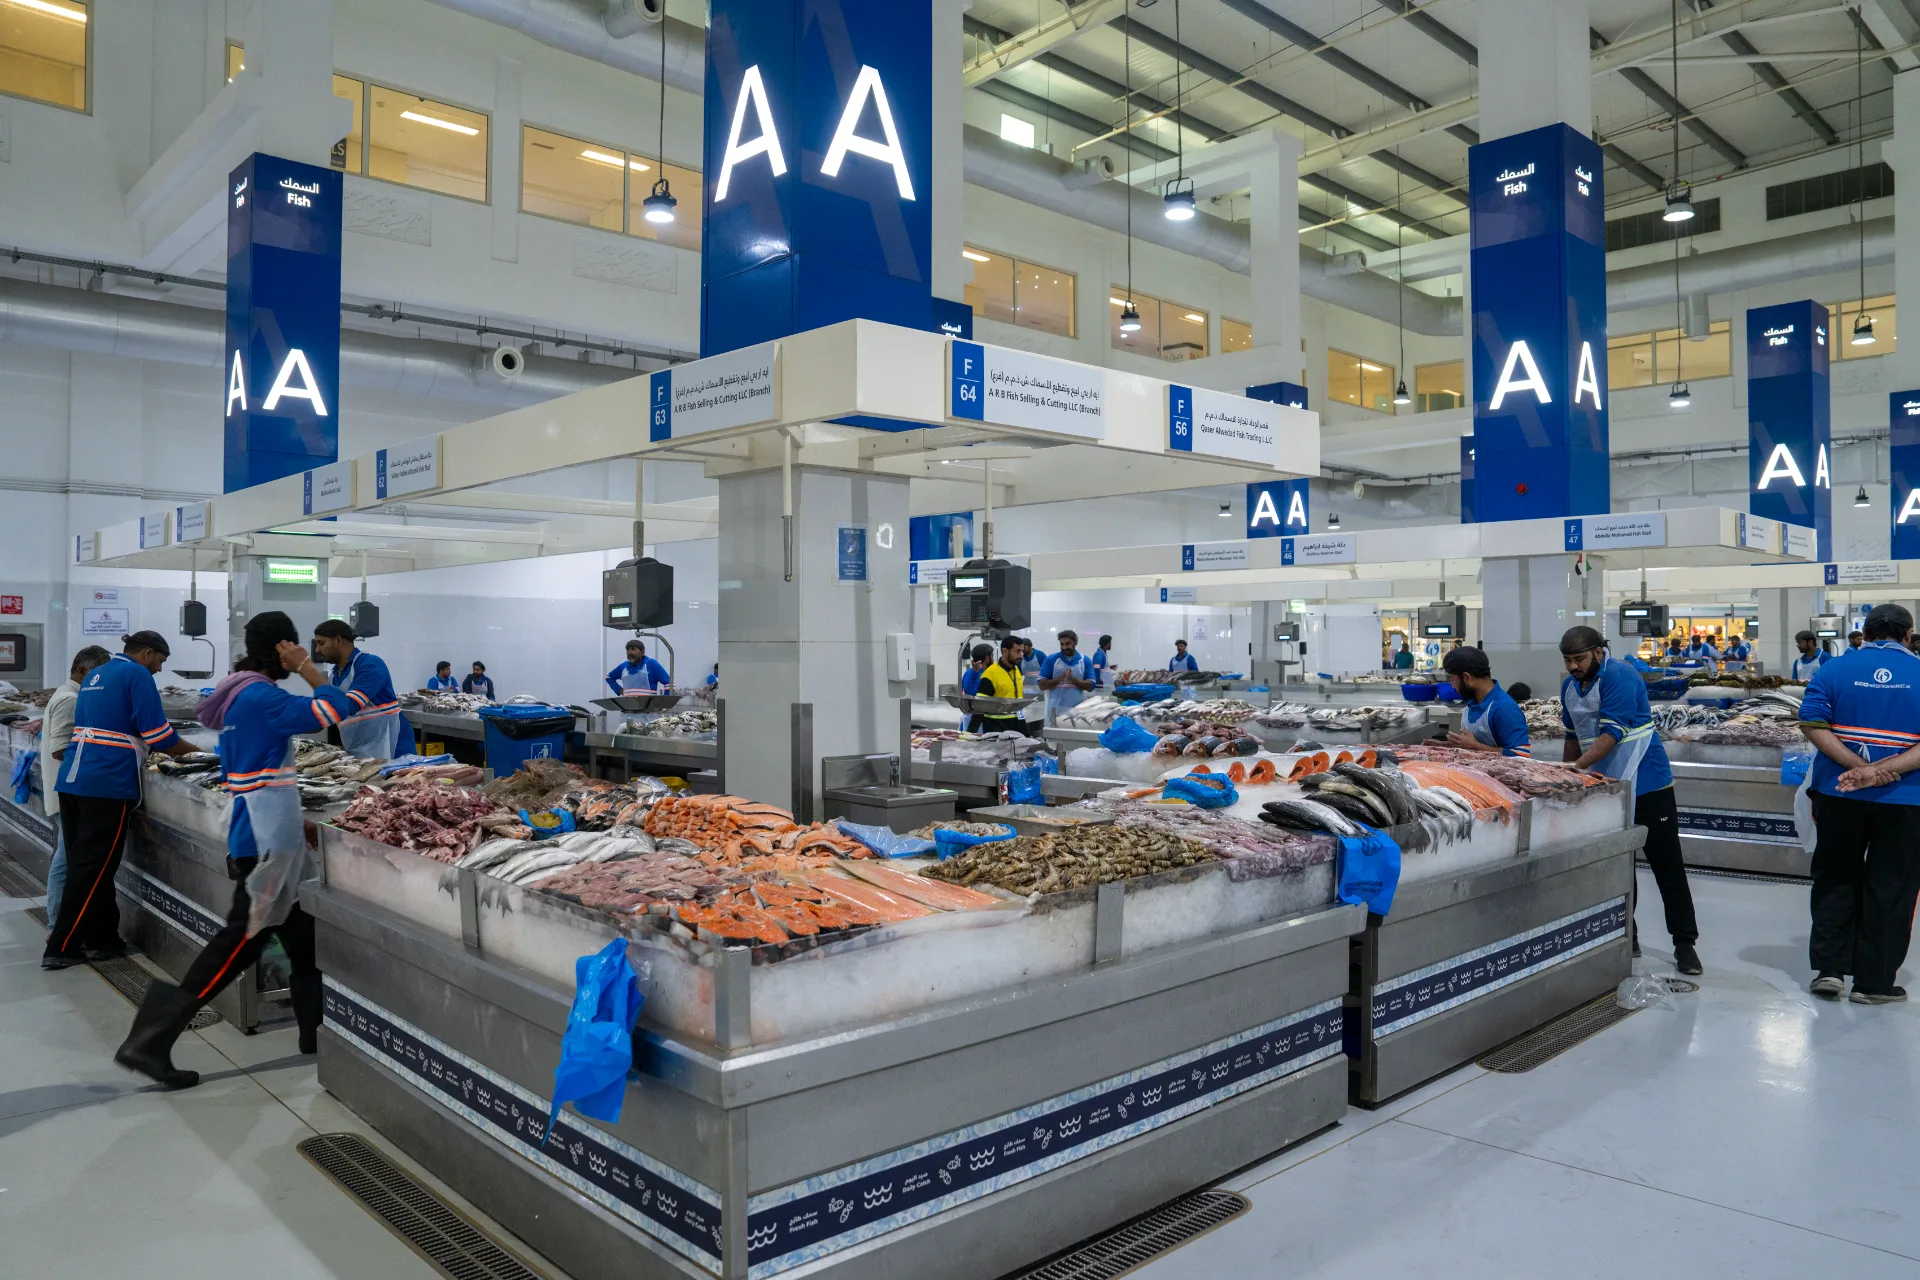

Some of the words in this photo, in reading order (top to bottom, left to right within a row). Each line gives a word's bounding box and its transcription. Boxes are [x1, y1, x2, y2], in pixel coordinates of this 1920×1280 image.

[714, 64, 788, 203] A
[819, 64, 916, 201] A
[1496, 163, 1535, 182] السمك
[279, 177, 319, 194] السمك
[1504, 181, 1527, 197] Fish
[287, 193, 311, 208] Fish
[1763, 324, 1794, 337] السمك
[1769, 335, 1788, 347] Fish
[964, 358, 973, 375] F
[1488, 339, 1553, 411] A
[226, 348, 248, 418] A
[262, 348, 328, 417] A
[1574, 340, 1602, 411] A
[657, 386, 664, 402] F
[674, 405, 679, 414] A
[679, 404, 683, 413] R
[687, 401, 697, 411] Fish
[697, 398, 714, 409] Selling
[714, 396, 719, 405] &
[719, 393, 738, 404] Cutting
[739, 389, 748, 400] LLC
[748, 384, 771, 399] (Branch)
[960, 384, 977, 402] 64
[989, 388, 994, 397] A
[995, 389, 1000, 398] R
[1000, 389, 1006, 399] B
[1006, 390, 1019, 401] Fish
[1020, 393, 1040, 407] Selling
[1040, 397, 1046, 406] &
[1047, 398, 1068, 412] Cutting
[1069, 402, 1078, 412] LLC
[1079, 403, 1101, 417] (Branch)
[1178, 399, 1185, 414] F
[655, 409, 666, 426] 63
[1175, 420, 1188, 437] 56
[1236, 430, 1245, 440] Fish
[1246, 432, 1262, 444] Trading
[379, 460, 384, 471] F
[1757, 443, 1807, 490] A
[1815, 443, 1831, 490] A
[1250, 490, 1281, 527] A
[1287, 490, 1307, 527] A
[1896, 488, 1920, 524] A
[1570, 525, 1577, 533] F
[1285, 543, 1290, 551] F
[1568, 536, 1579, 544] 47
[1184, 558, 1192, 566] 45
[1283, 552, 1293, 560] 46
[1003, 1148, 1016, 1157] Fresh
[1016, 1145, 1026, 1153] Fish
[902, 1183, 916, 1194] Daily
[917, 1178, 931, 1188] Catch
[789, 1222, 806, 1234] Fresh
[806, 1218, 819, 1228] Fish
